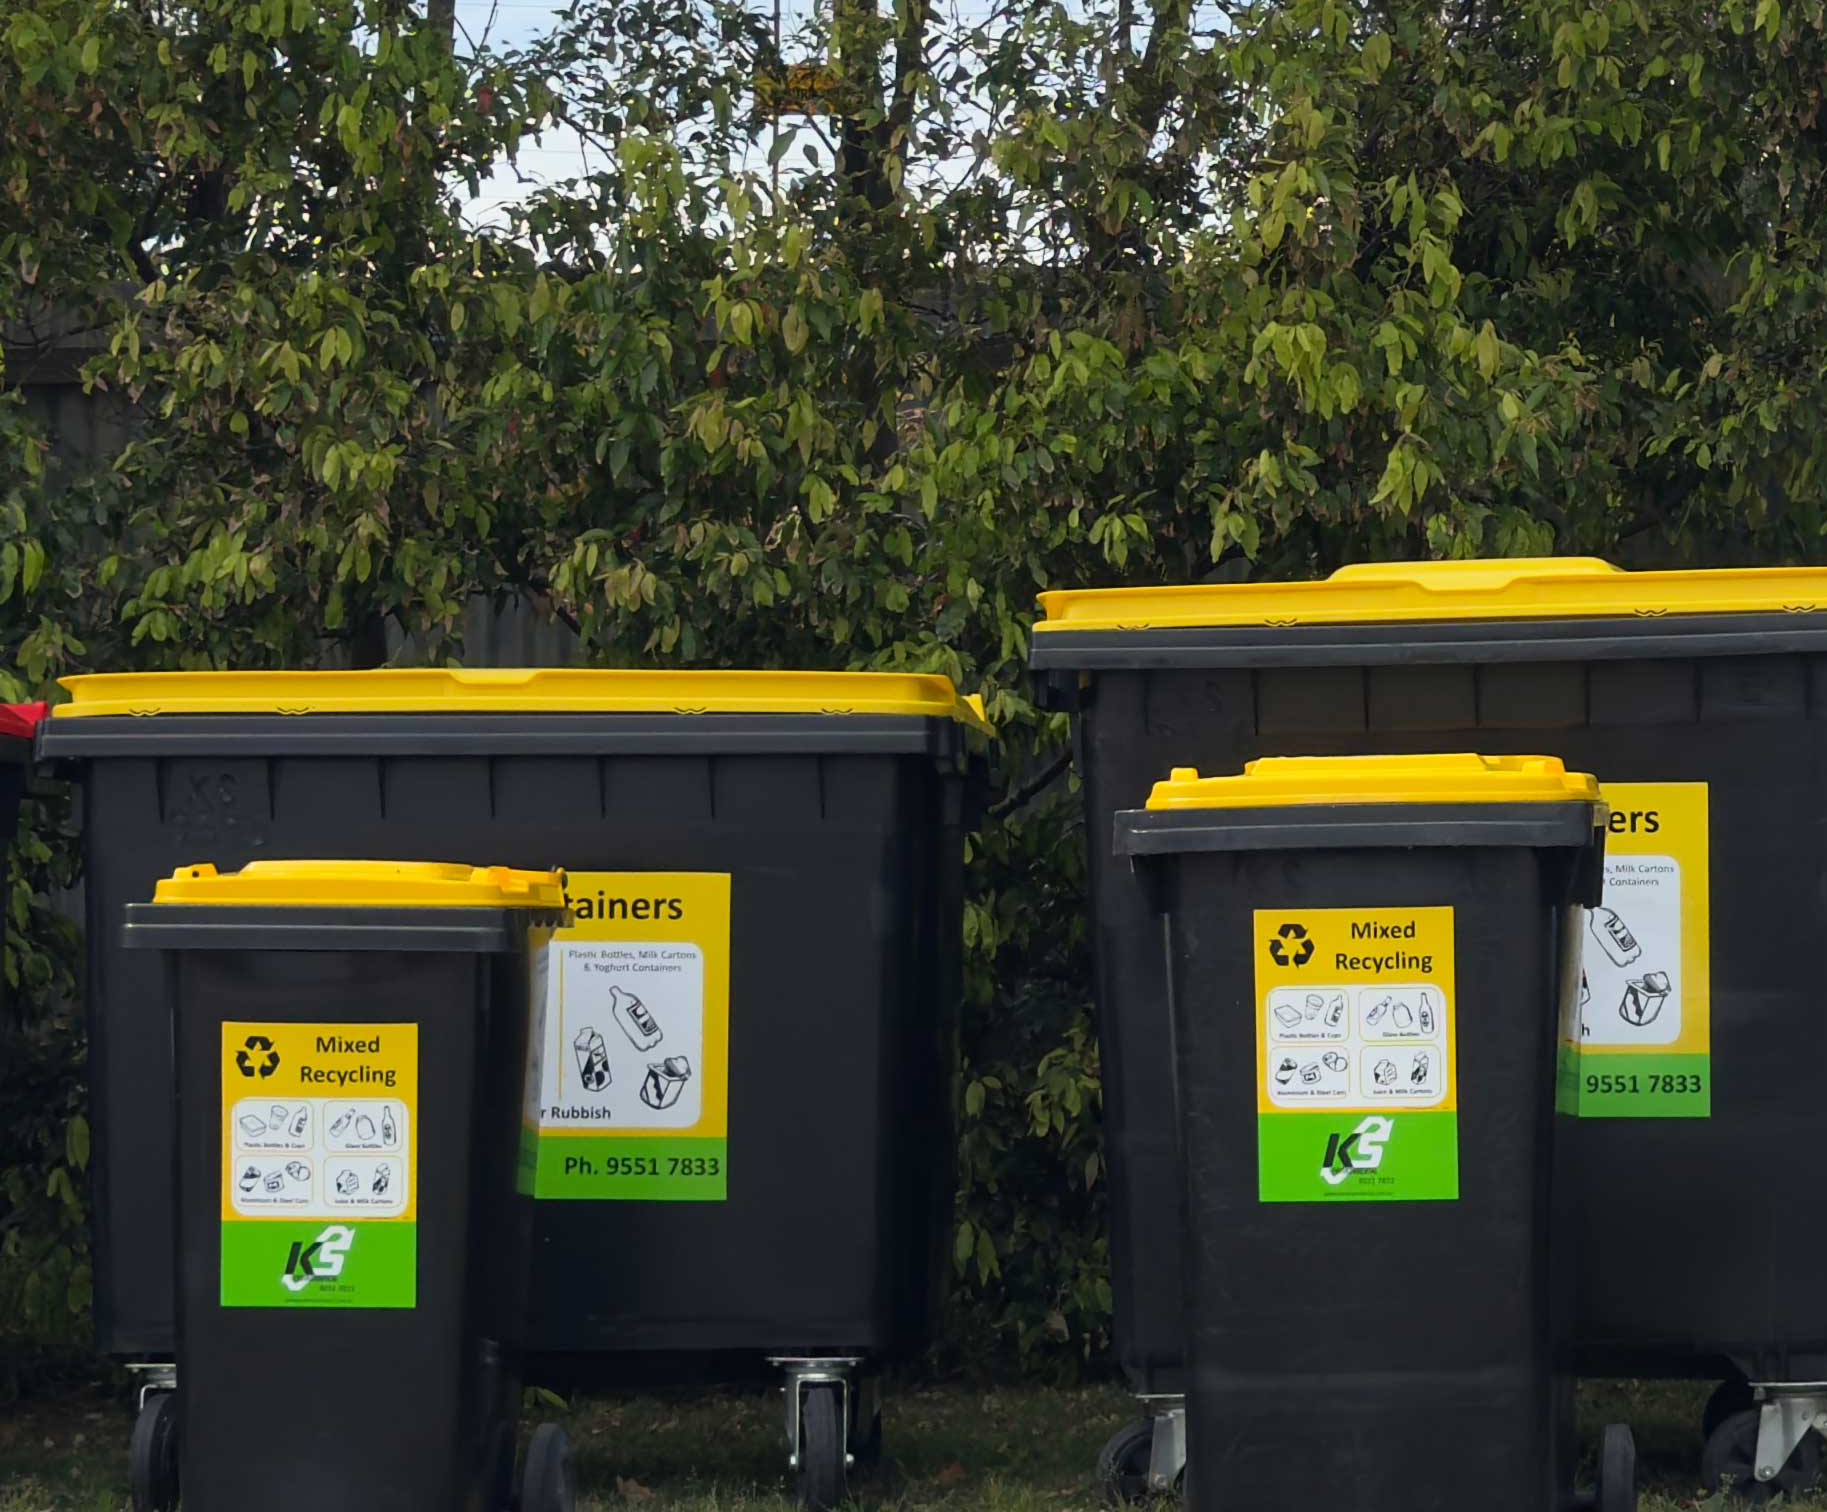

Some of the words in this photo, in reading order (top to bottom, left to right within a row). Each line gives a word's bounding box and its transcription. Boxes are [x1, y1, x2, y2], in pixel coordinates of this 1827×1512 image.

[1639, 865, 1674, 873] Cartons
[1351, 921, 1416, 939] Mixed
[661, 950, 696, 959] Cartons
[1336, 952, 1432, 973] Recycling
[594, 963, 629, 974] Yoghurt
[632, 963, 681, 972] Containers
[316, 1036, 380, 1053] Mixed
[300, 1065, 396, 1087] Recycling
[1586, 1074, 1640, 1094] 9551
[1648, 1074, 1702, 1094] 7833
[551, 1106, 611, 1120] Rubbish
[1320, 1116, 1395, 1185] KS
[565, 1156, 598, 1175] Ph.
[606, 1157, 660, 1176] 9551
[667, 1157, 720, 1176] 7833
[282, 1224, 355, 1291] KS
